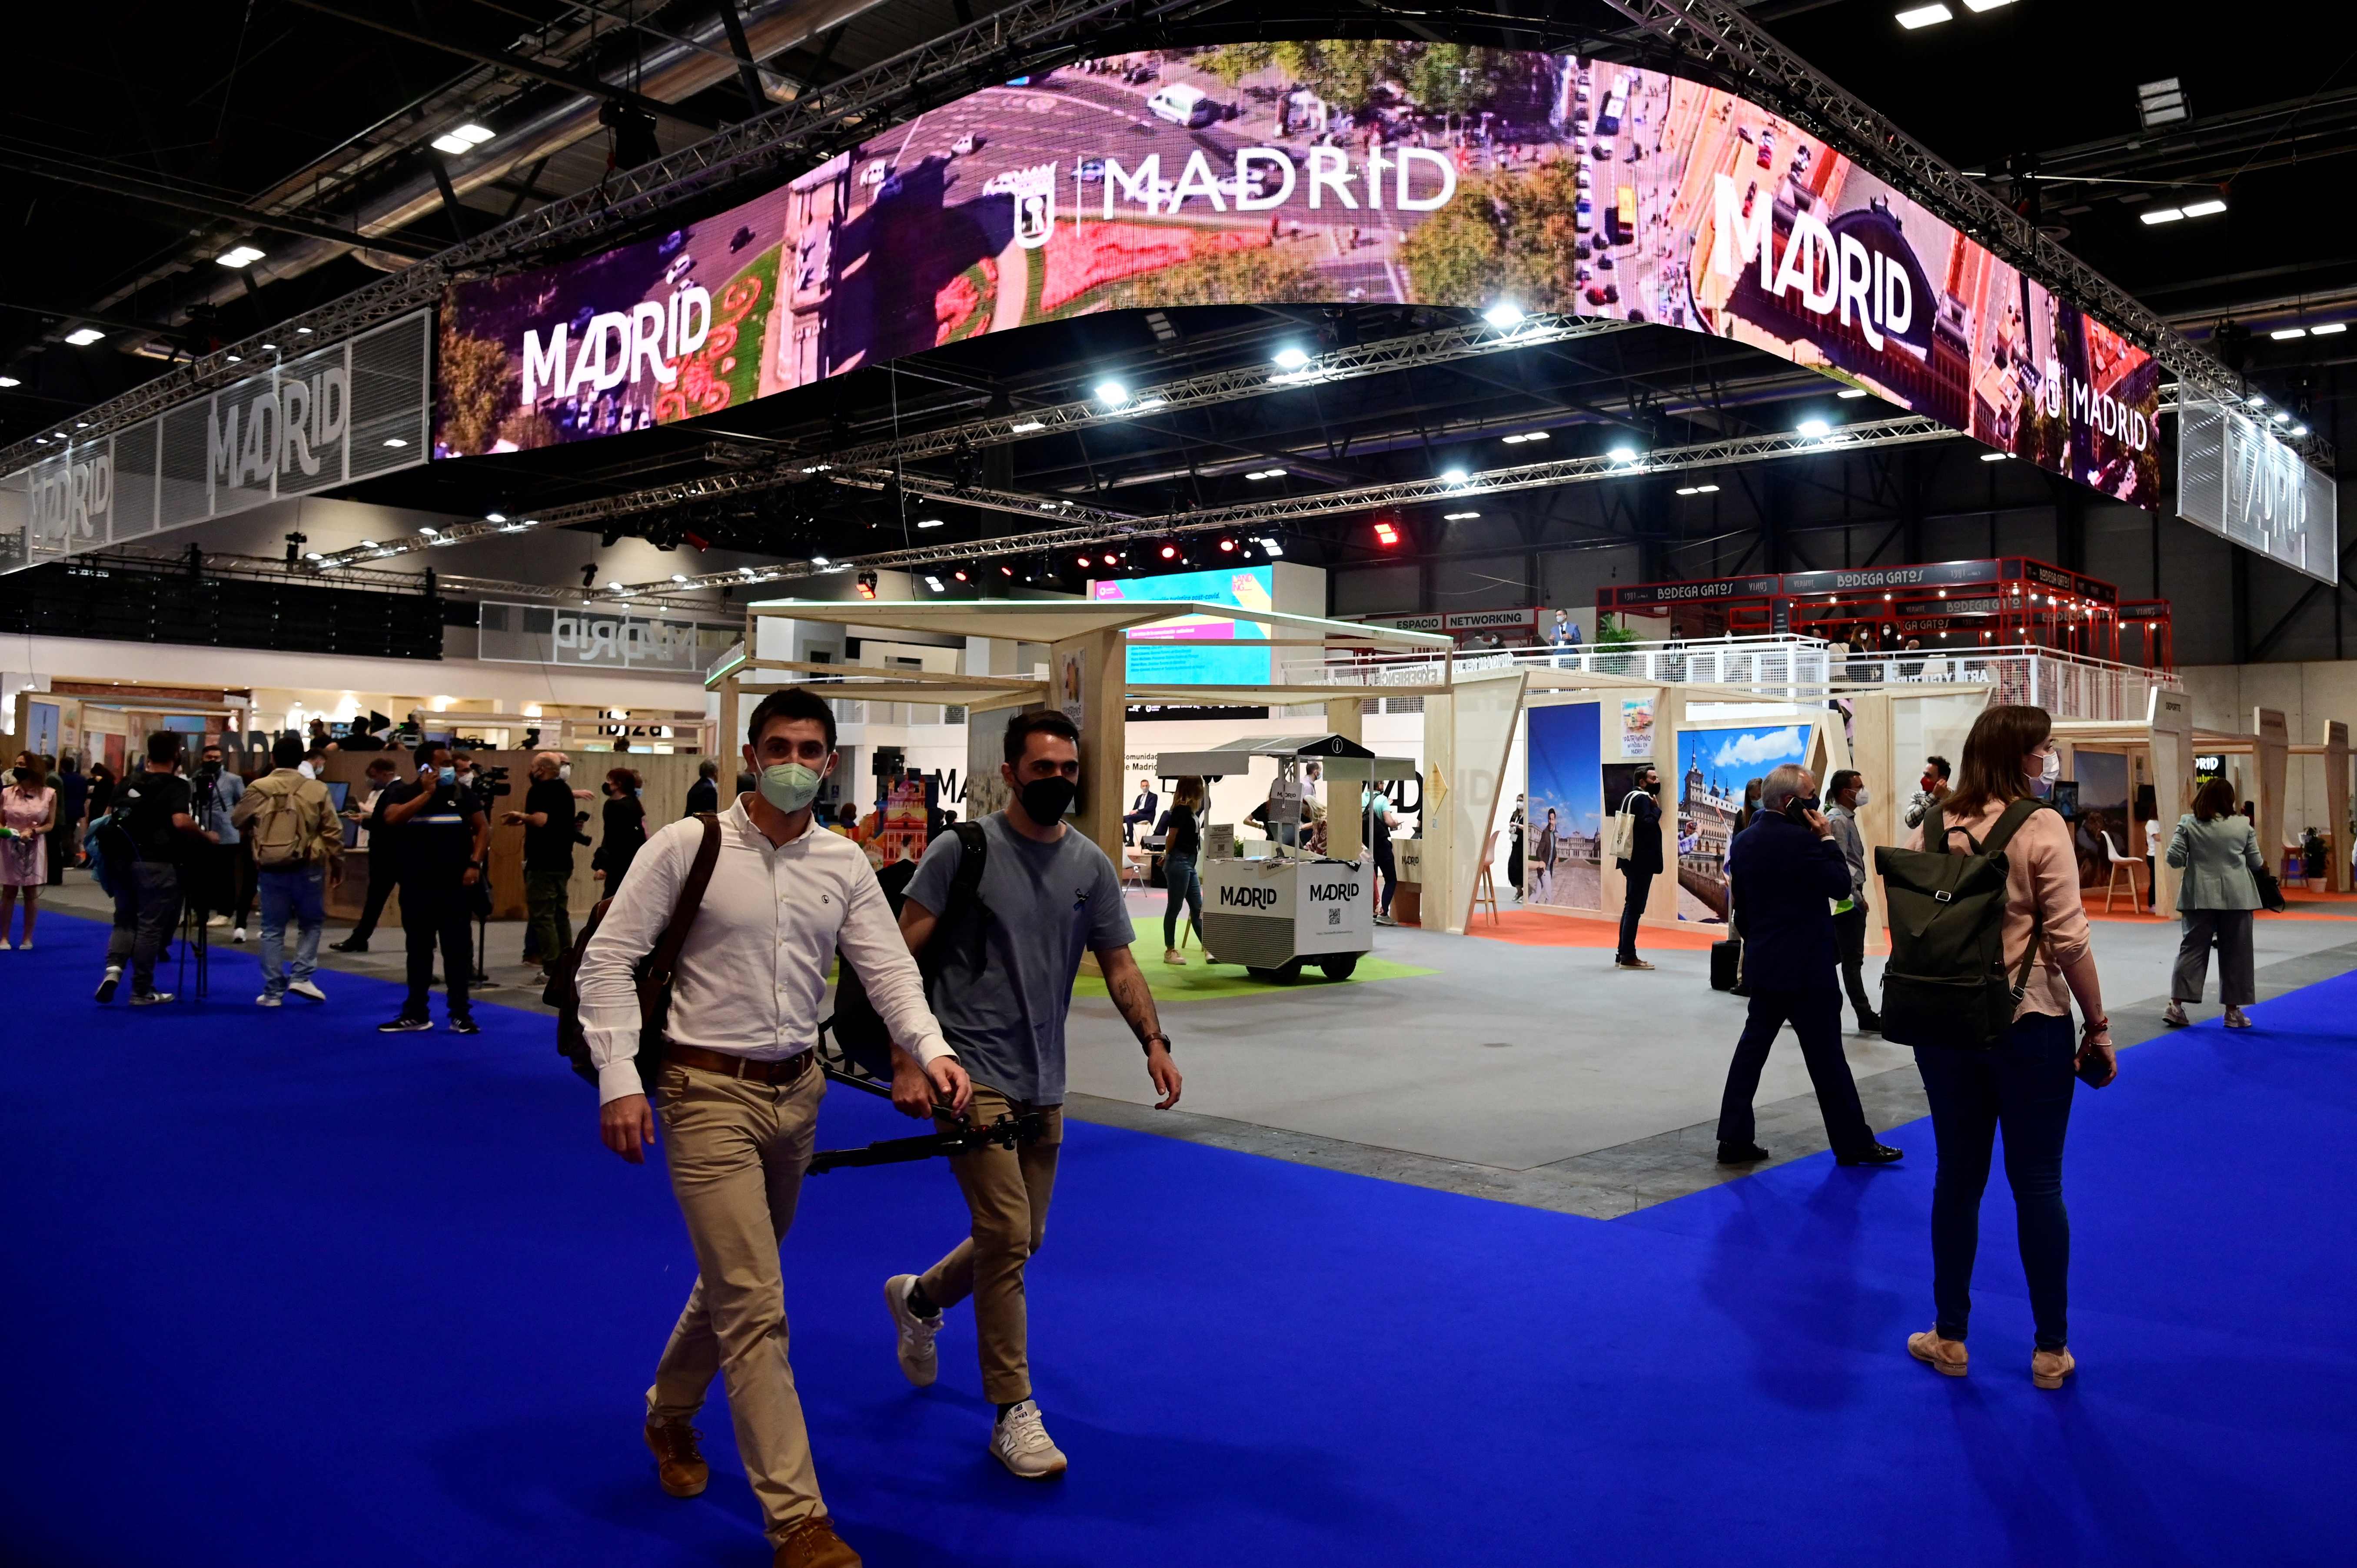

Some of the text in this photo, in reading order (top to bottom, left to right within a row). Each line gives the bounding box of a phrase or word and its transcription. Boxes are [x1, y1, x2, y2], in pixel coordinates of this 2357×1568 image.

[1103, 146, 1458, 219] MADRID
[1714, 173, 1912, 352] MADRID
[521, 286, 712, 405] MADRID
[2072, 377, 2147, 451] MADRID
[206, 367, 347, 495] MADRID
[2227, 425, 2309, 553] MADRID
[31, 455, 111, 547] MADRID
[1232, 574, 1252, 584] LAND
[1837, 572, 1883, 587] BODEGA
[1886, 570, 1923, 584] GATOS
[1657, 586, 1699, 600] BODEGA
[1700, 583, 1733, 597] GATOS
[1946, 599, 1989, 613] BODEGA
[1396, 618, 1439, 630] ESPACIO
[1450, 613, 1522, 627] NETWORKING
[1920, 619, 1950, 630] GATOS
[1401, 856, 1419, 866] MADRID
[1220, 885, 1277, 910] MADRID
[1310, 883, 1359, 902] MADRID
